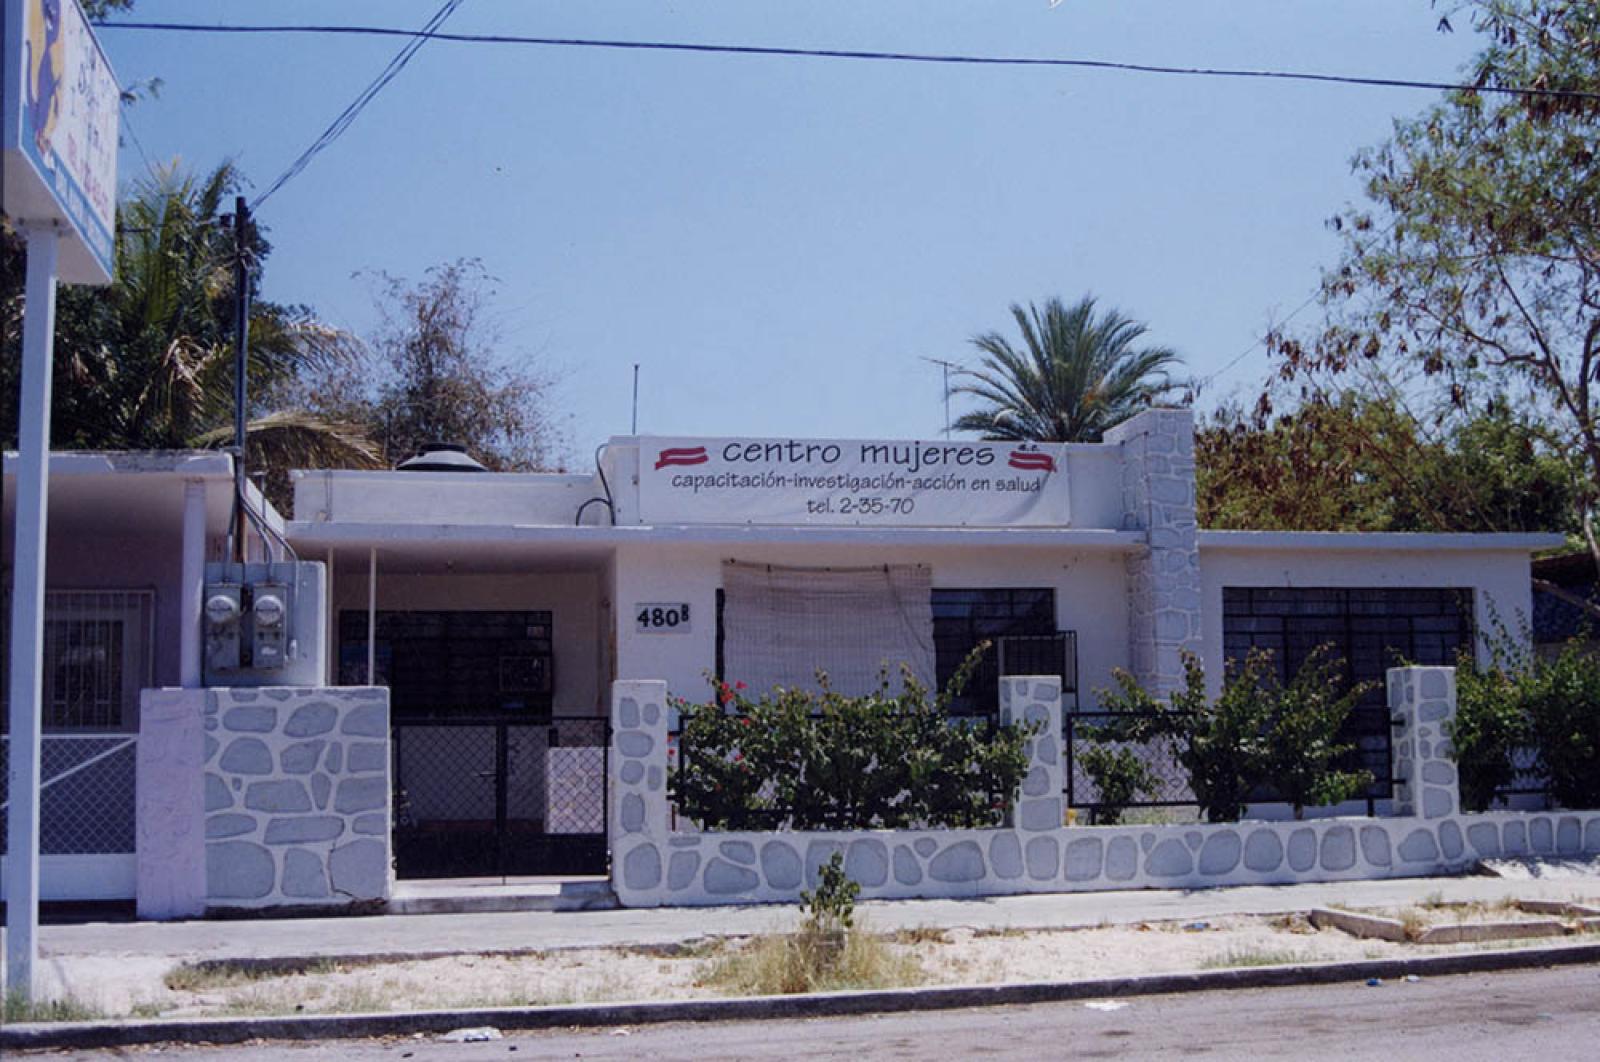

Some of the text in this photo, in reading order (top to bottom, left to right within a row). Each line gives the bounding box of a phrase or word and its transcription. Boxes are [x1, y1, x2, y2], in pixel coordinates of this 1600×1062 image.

[722, 440, 995, 472] centro mujeres
[672, 470, 1041, 493] capacitación-investigación-acción en salud
[806, 497, 915, 514] tel. 2-35-70
